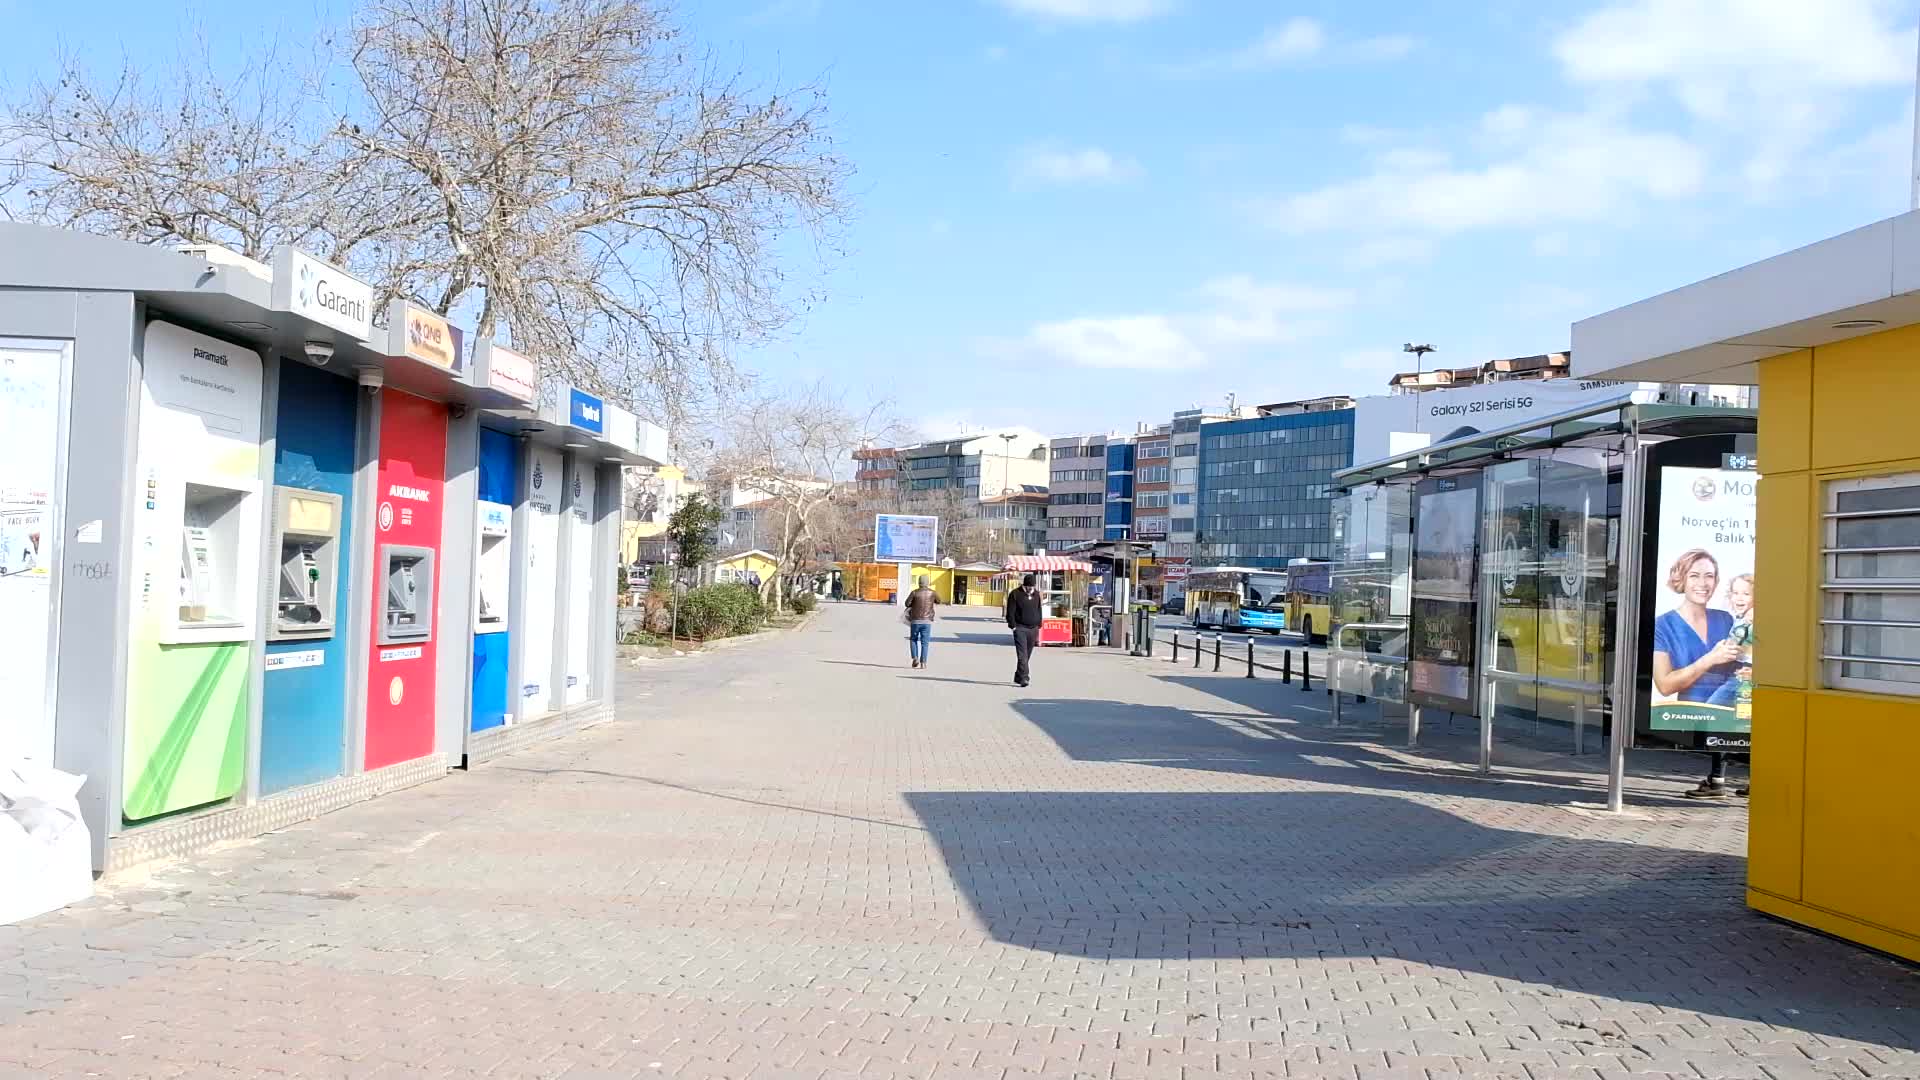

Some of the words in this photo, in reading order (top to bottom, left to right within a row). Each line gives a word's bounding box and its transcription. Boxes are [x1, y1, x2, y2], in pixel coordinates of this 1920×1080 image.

[316, 279, 365, 323] Garanti
[423, 324, 442, 345] QNB
[193, 346, 229, 367] paramatik
[1430, 404, 1467, 417] Galaxy
[1469, 400, 1484, 413] S21
[1486, 396, 1516, 412] Serisi
[1517, 396, 1533, 408] 5G
[389, 484, 430, 502] AKBANK
[1681, 515, 1740, 531] Norveç'in
[1744, 519, 1750, 529] 1
[1715, 532, 1745, 544] Balık
[1671, 713, 1716, 721] FARMAVITA
